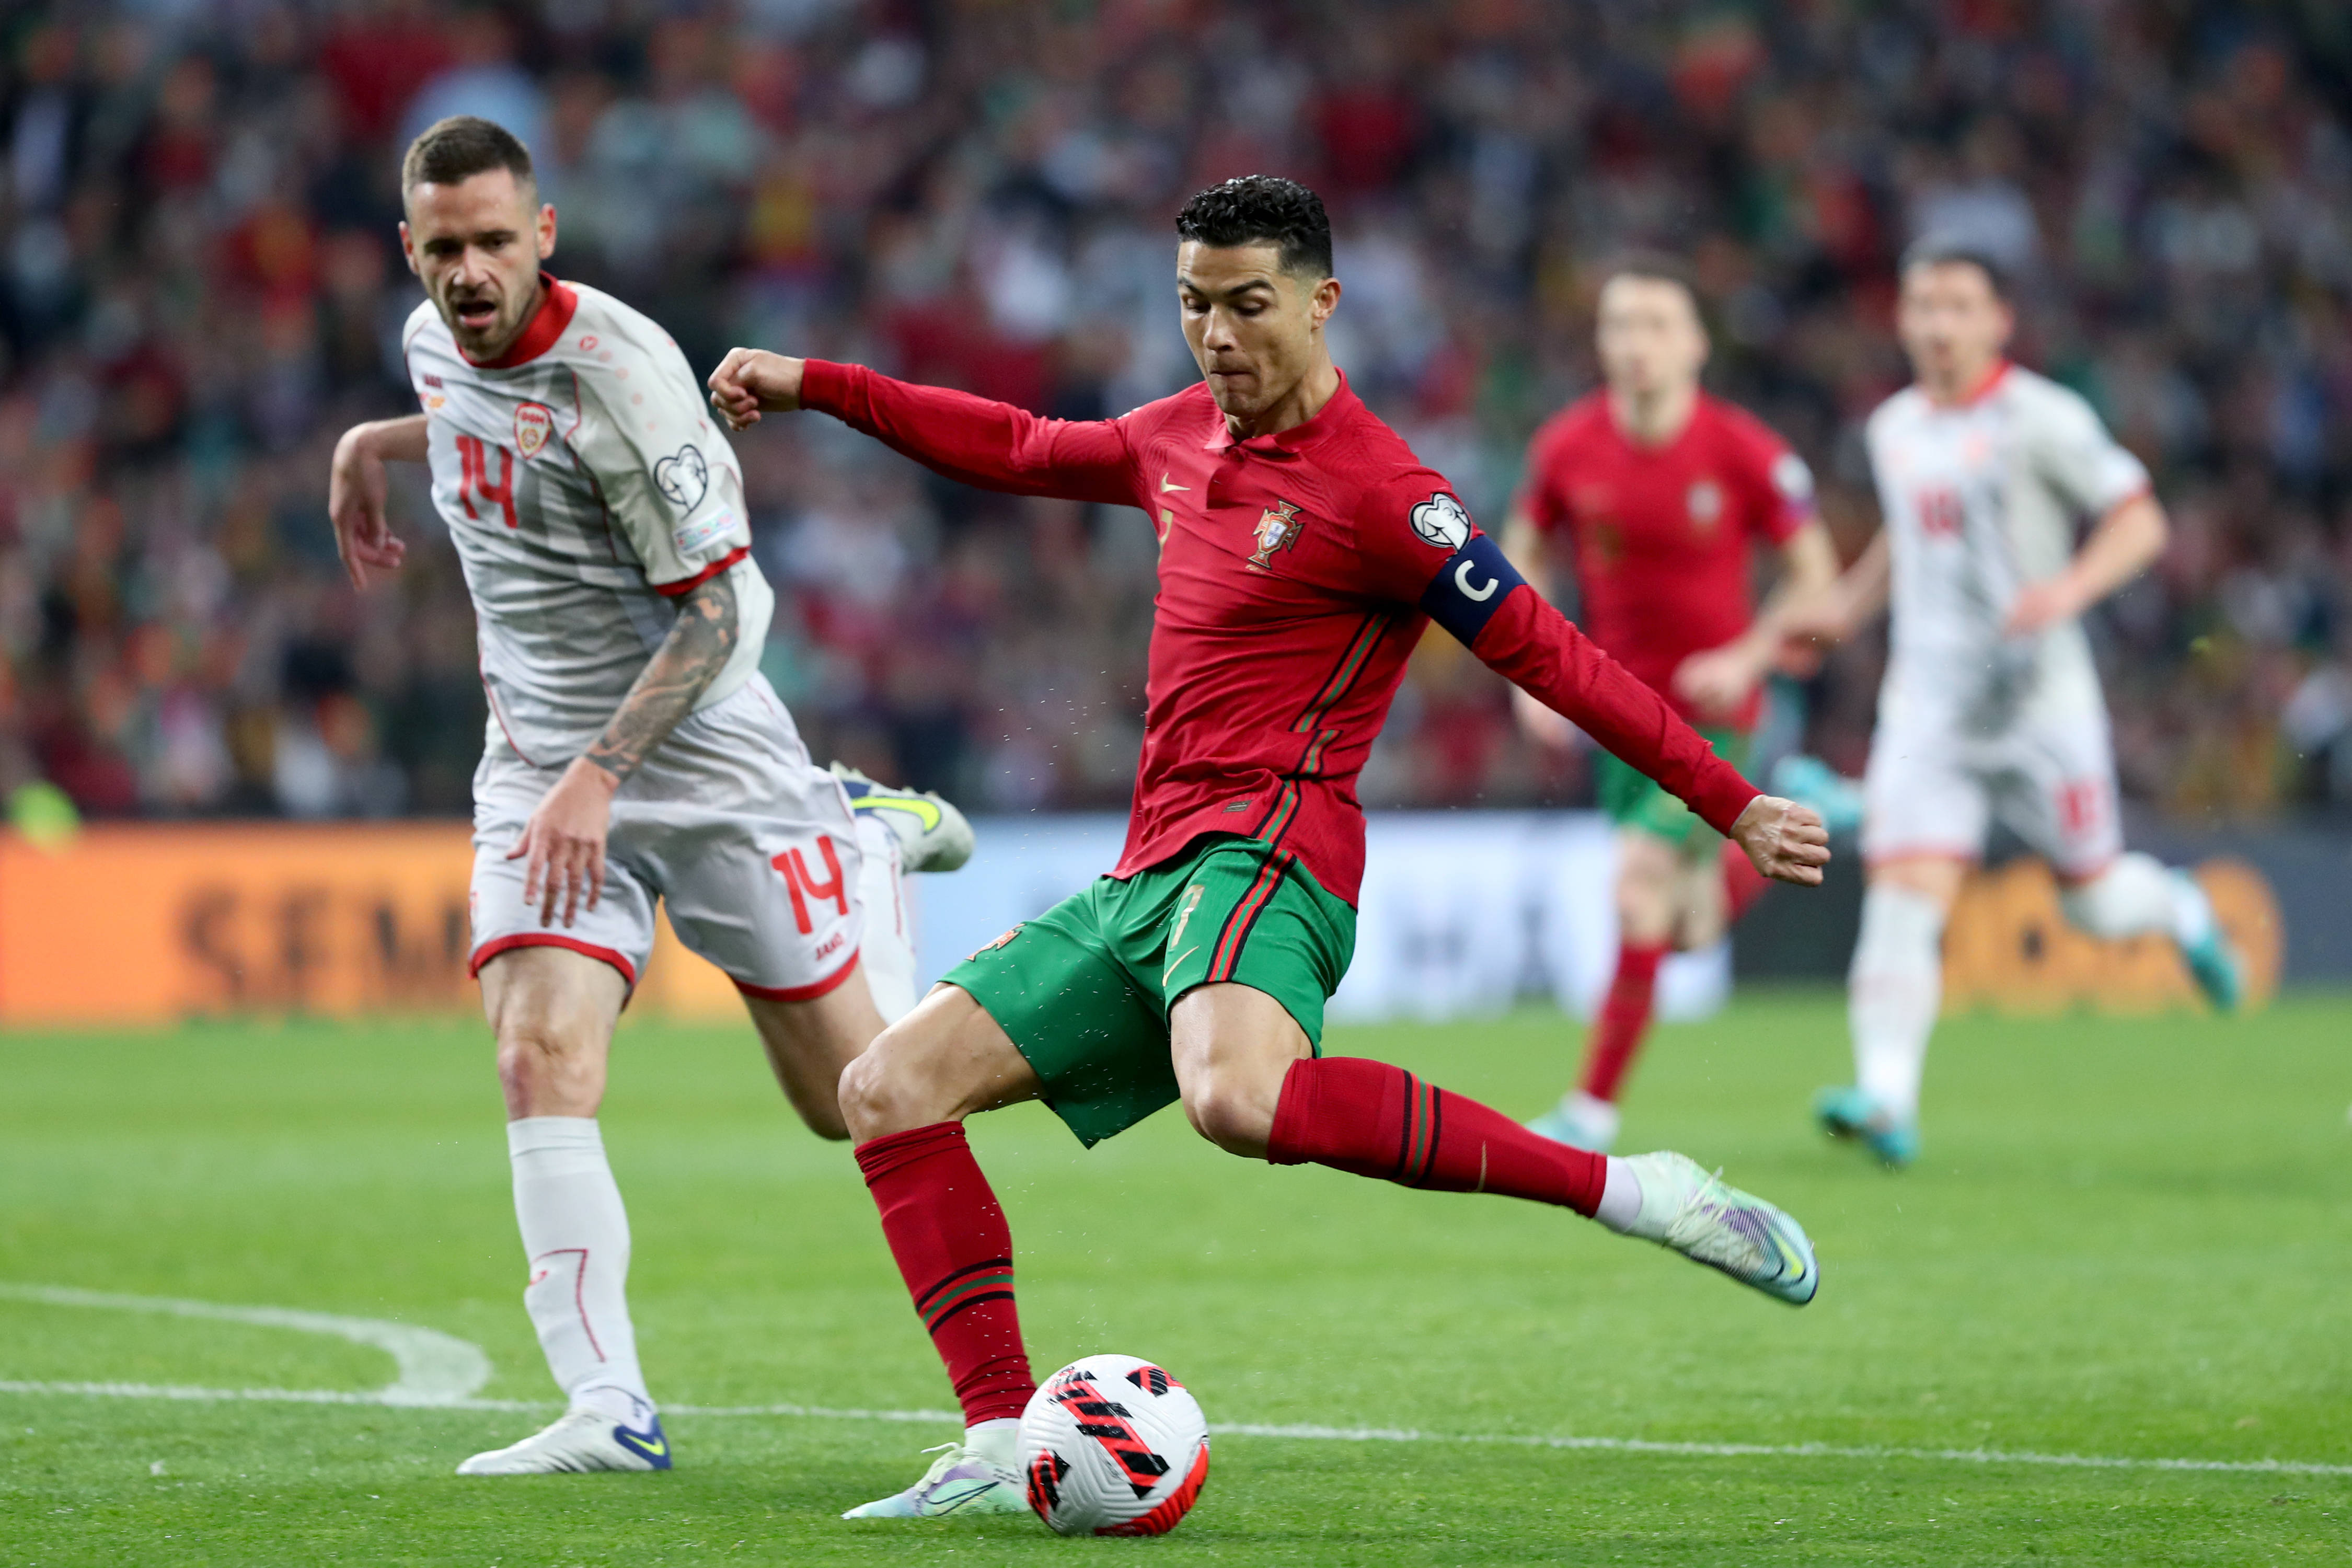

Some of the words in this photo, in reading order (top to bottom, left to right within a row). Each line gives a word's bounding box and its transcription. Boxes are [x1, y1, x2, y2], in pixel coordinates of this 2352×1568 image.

[455, 434, 518, 529] 14
[1455, 559, 1499, 602] C
[770, 835, 849, 935] 14
[1171, 883, 1205, 949] 7
